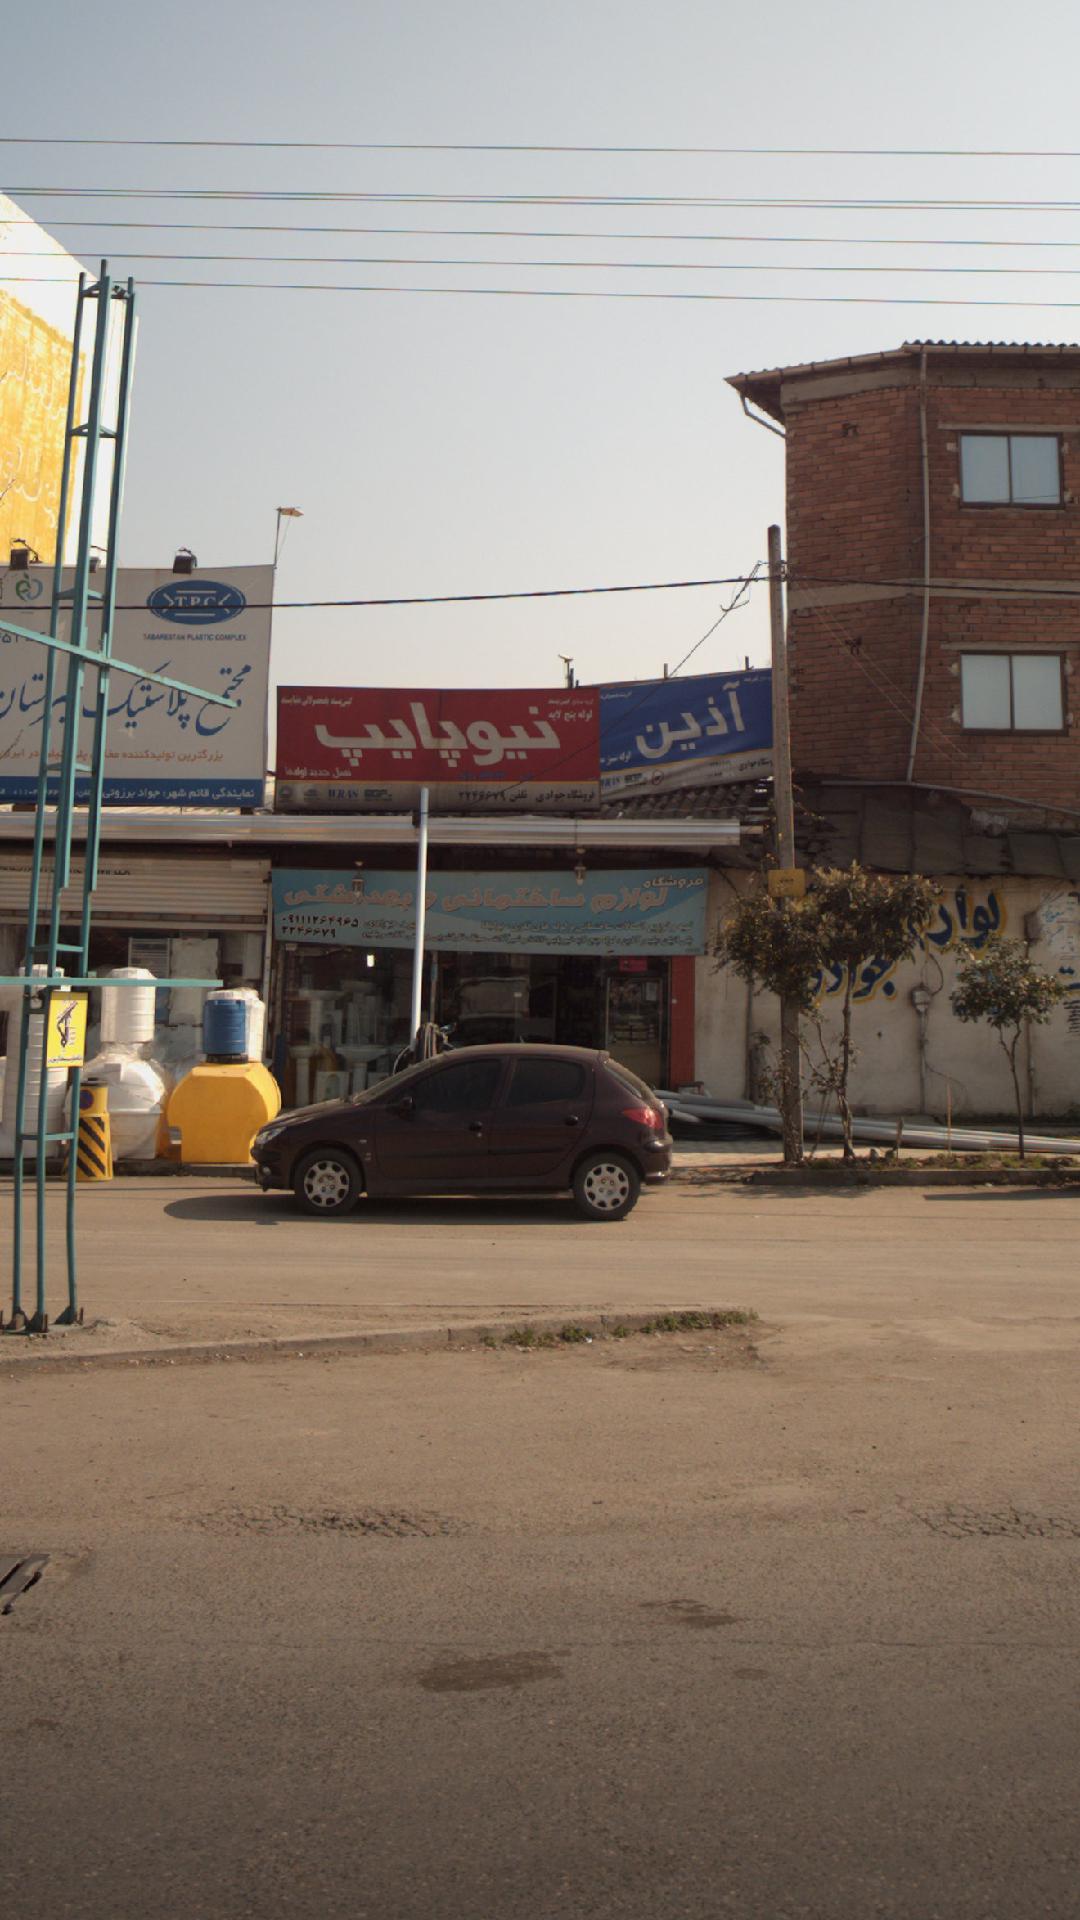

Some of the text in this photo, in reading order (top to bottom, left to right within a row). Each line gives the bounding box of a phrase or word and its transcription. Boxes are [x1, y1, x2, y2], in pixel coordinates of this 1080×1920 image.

[143, 633, 247, 641] TABARESTAN PLASTIC COMPLEX
[635, 680, 745, 760] آذین
[314, 702, 562, 768] نیوپایپ
[211, 787, 255, 800] نمایندگی
[642, 875, 704, 889] فروشگاه
[283, 882, 414, 911] بهدشتی
[442, 886, 586, 913] ساختمانی
[590, 885, 669, 915] لوازم
